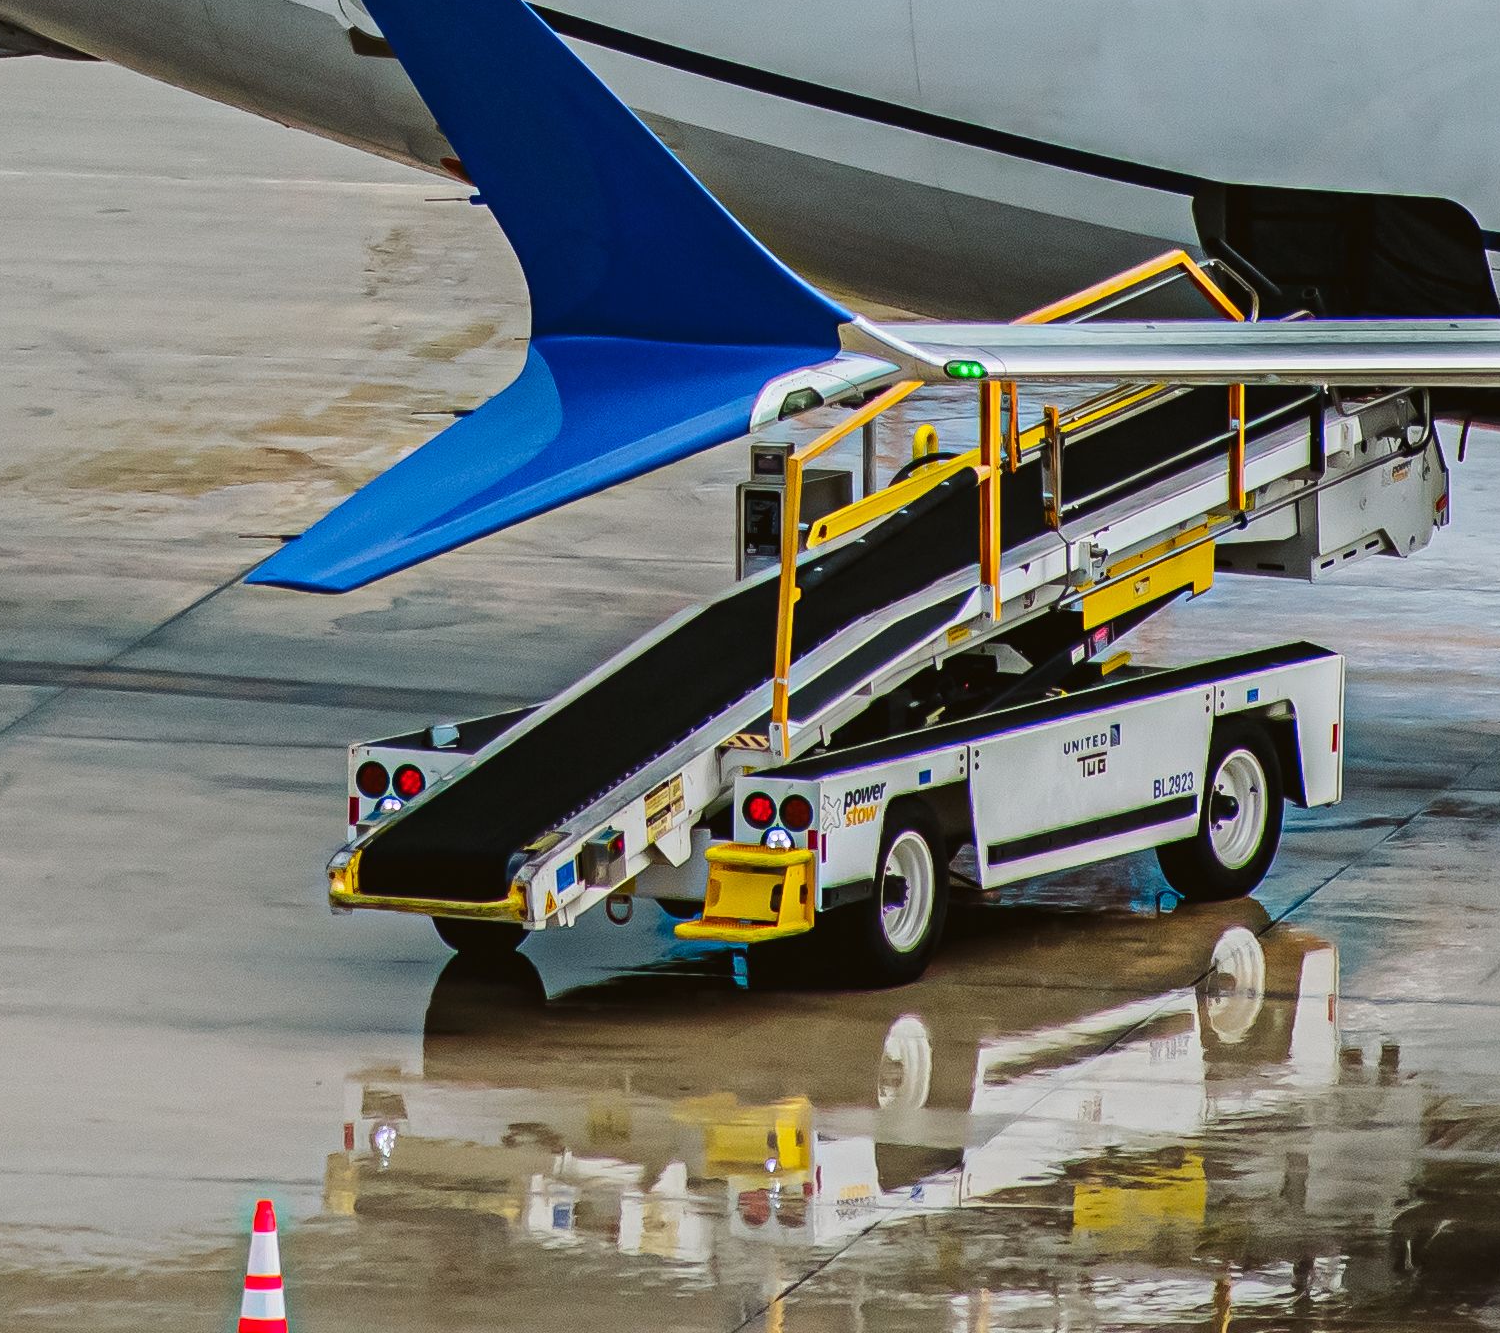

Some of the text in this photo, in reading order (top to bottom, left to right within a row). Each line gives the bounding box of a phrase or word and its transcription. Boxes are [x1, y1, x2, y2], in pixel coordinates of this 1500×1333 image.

[1063, 733, 1107, 755] UNITED
[1153, 771, 1194, 799] BL2923
[843, 782, 886, 815] power
[845, 804, 878, 827] stow
